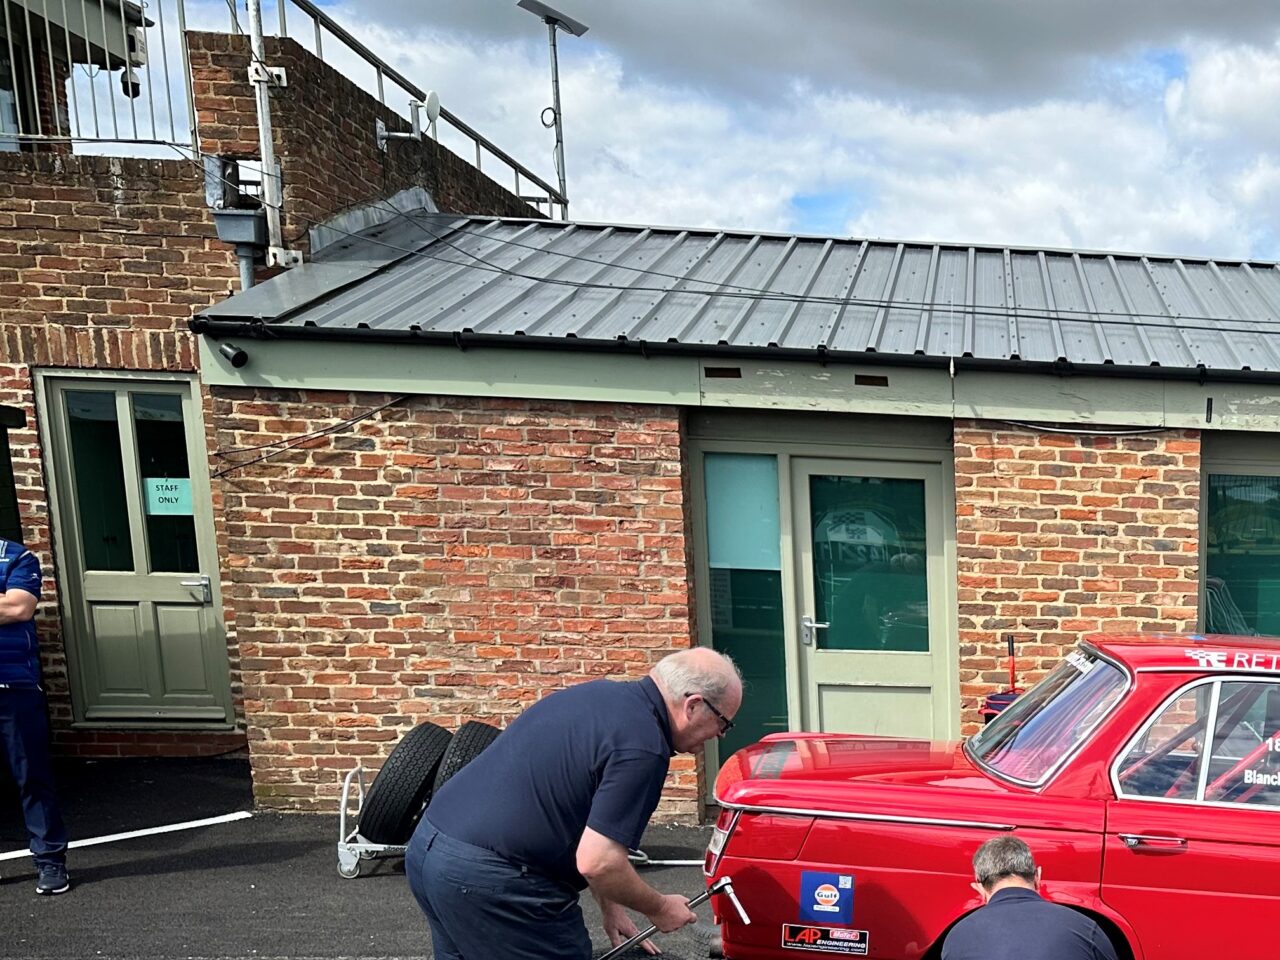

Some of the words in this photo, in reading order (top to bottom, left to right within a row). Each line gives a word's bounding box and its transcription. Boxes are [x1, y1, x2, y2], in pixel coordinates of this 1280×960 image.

[155, 484, 179, 492] STAFF
[158, 496, 179, 504] ONLY
[816, 891, 838, 899] Gulf
[784, 926, 822, 944] LAP
[816, 939, 866, 949] ENGINEERING
